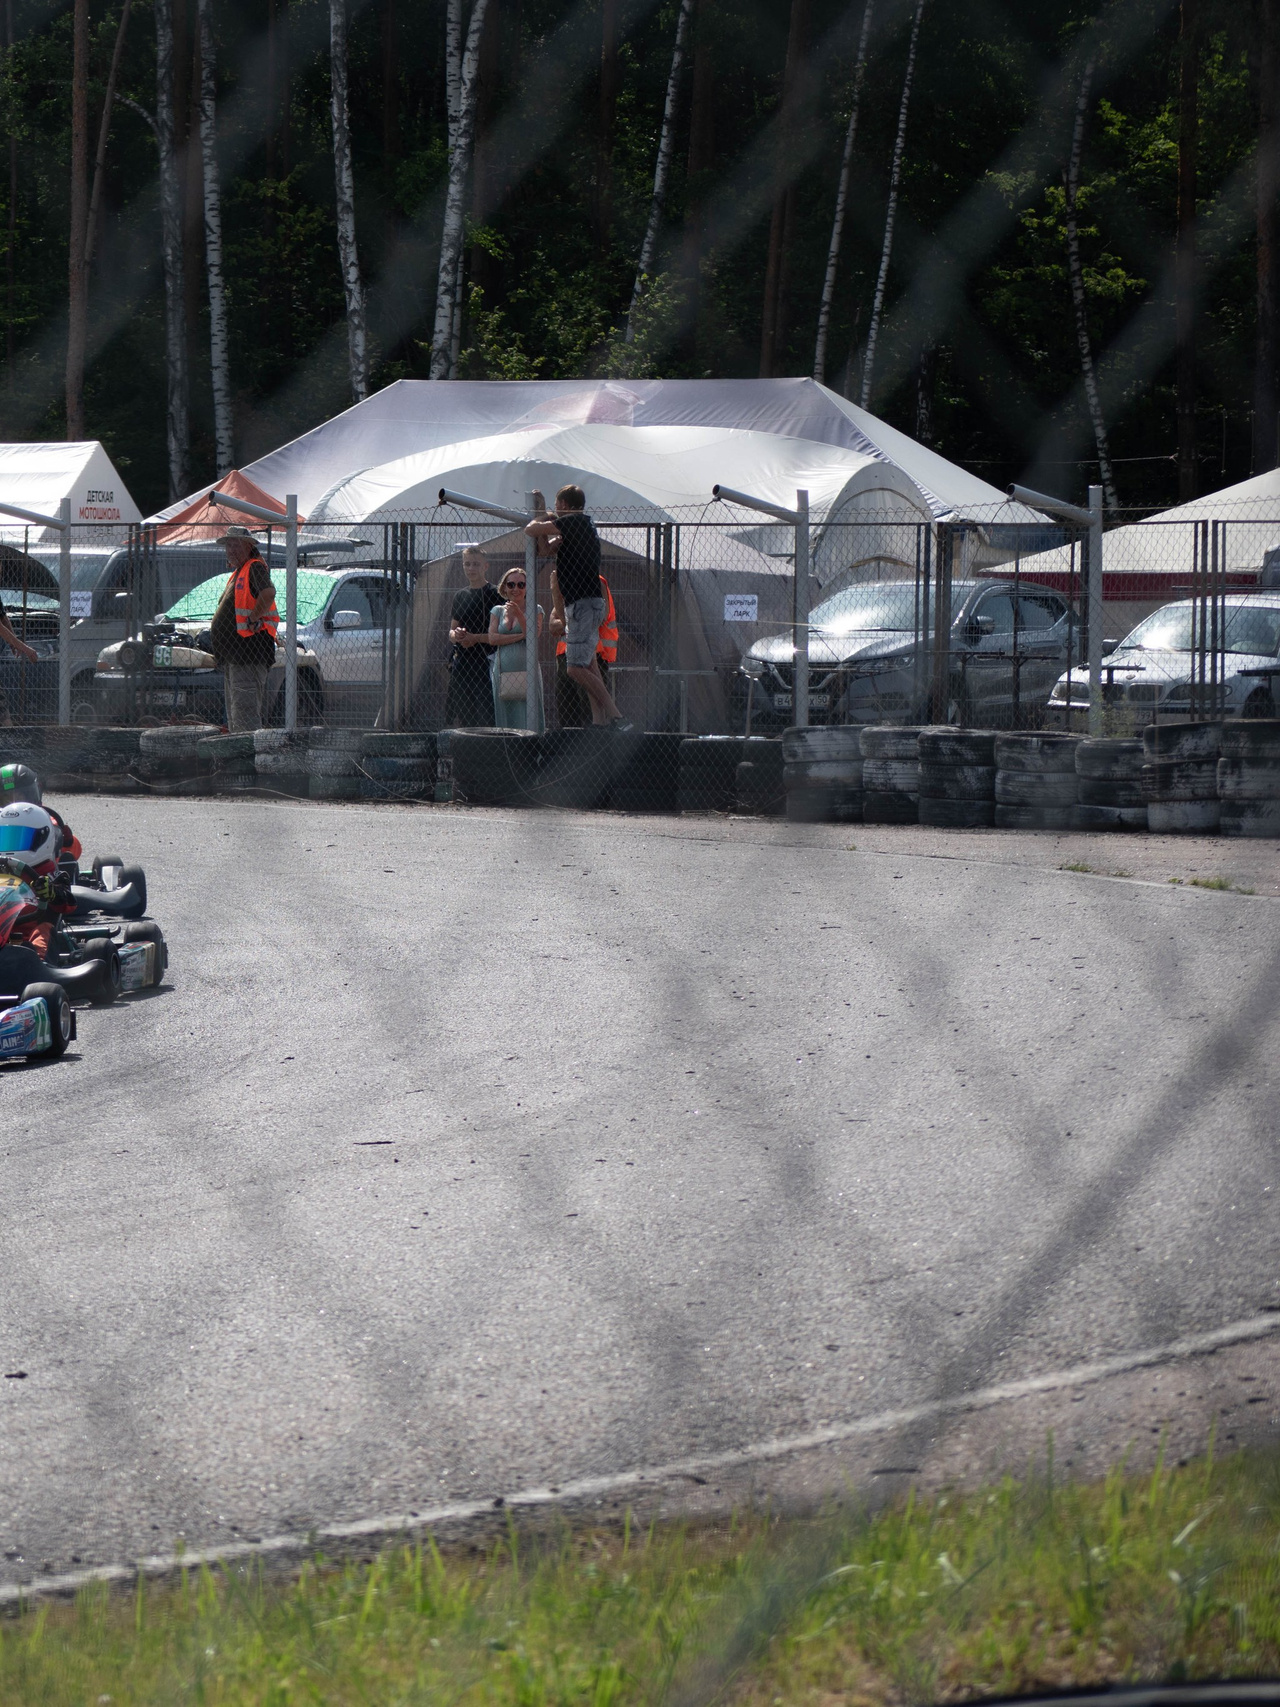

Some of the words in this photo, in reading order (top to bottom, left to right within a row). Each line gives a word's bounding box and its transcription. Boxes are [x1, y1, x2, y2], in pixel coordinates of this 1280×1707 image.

[86, 490, 114, 504] ДЕТСКАЯ
[79, 507, 121, 521] МОТОШКОЛА
[155, 647, 171, 666] 96
[33, 1001, 51, 1045] 22
